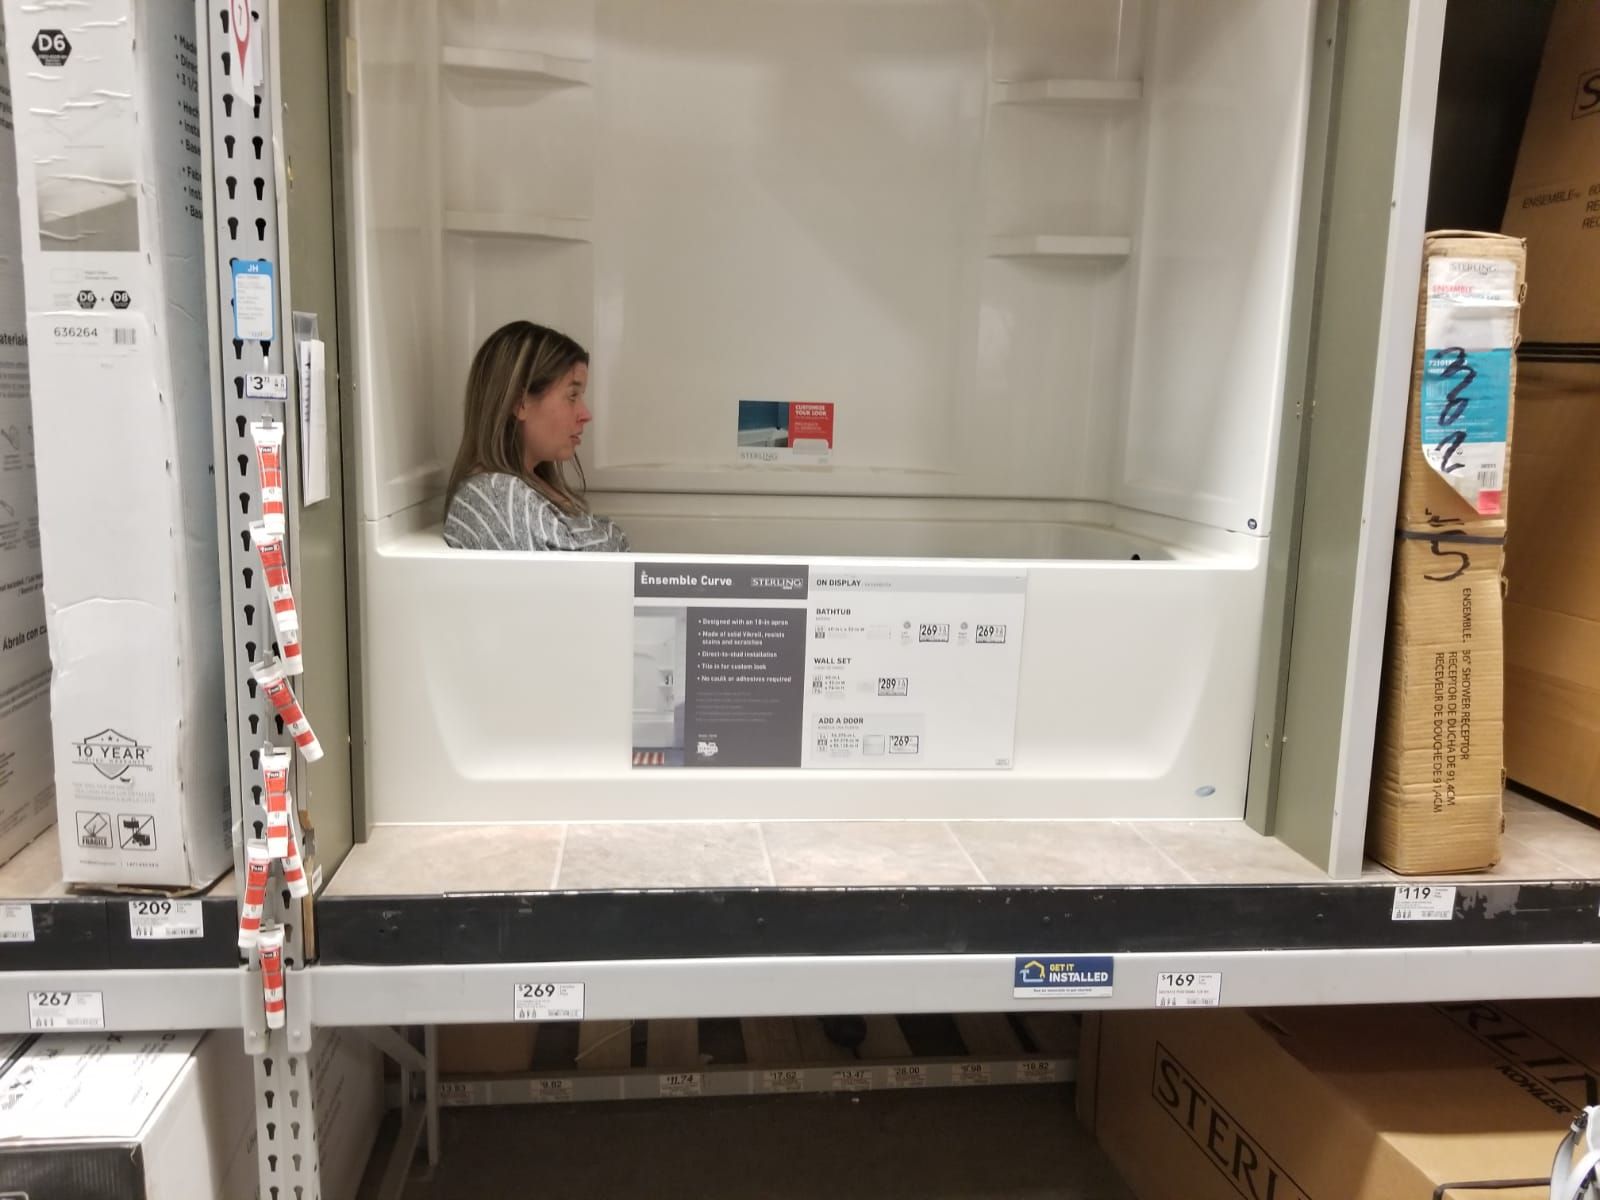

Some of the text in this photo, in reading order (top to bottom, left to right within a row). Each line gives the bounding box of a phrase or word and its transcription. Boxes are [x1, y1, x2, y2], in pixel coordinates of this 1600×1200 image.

[38, 33, 65, 51] D6
[247, 264, 259, 272] JH
[54, 327, 98, 338] 636264
[640, 573, 802, 588] Ensemble Curve STERLING
[816, 579, 828, 587] ON
[829, 579, 862, 587] DISPLAY
[816, 608, 851, 616] BATHTUB
[702, 617, 730, 626] Designed
[702, 630, 719, 638] Made
[813, 657, 852, 665] WALL SET
[1434, 652, 1445, 704] RECEVEUR
[1447, 651, 1458, 704] RECEPTOR
[1460, 665, 1472, 711] SHOWER
[1434, 705, 1444, 717] DE
[1447, 705, 1457, 717] DE
[818, 717, 864, 725] ADD A DOOR
[1433, 719, 1443, 762] DOUCHE
[1447, 718, 1457, 754] DUCHA
[1459, 711, 1471, 761] RECEPTOR
[77, 745, 145, 760] 10 YEAR
[1433, 763, 1443, 776] DE
[1446, 756, 1456, 771] DE
[82, 838, 108, 847] FRAGILE
[1050, 963, 1075, 972] GET IT
[1049, 972, 1108, 983] INSTALLED
[1161, 974, 1195, 987] $169
[1495, 1064, 1572, 1114] KOHLER
